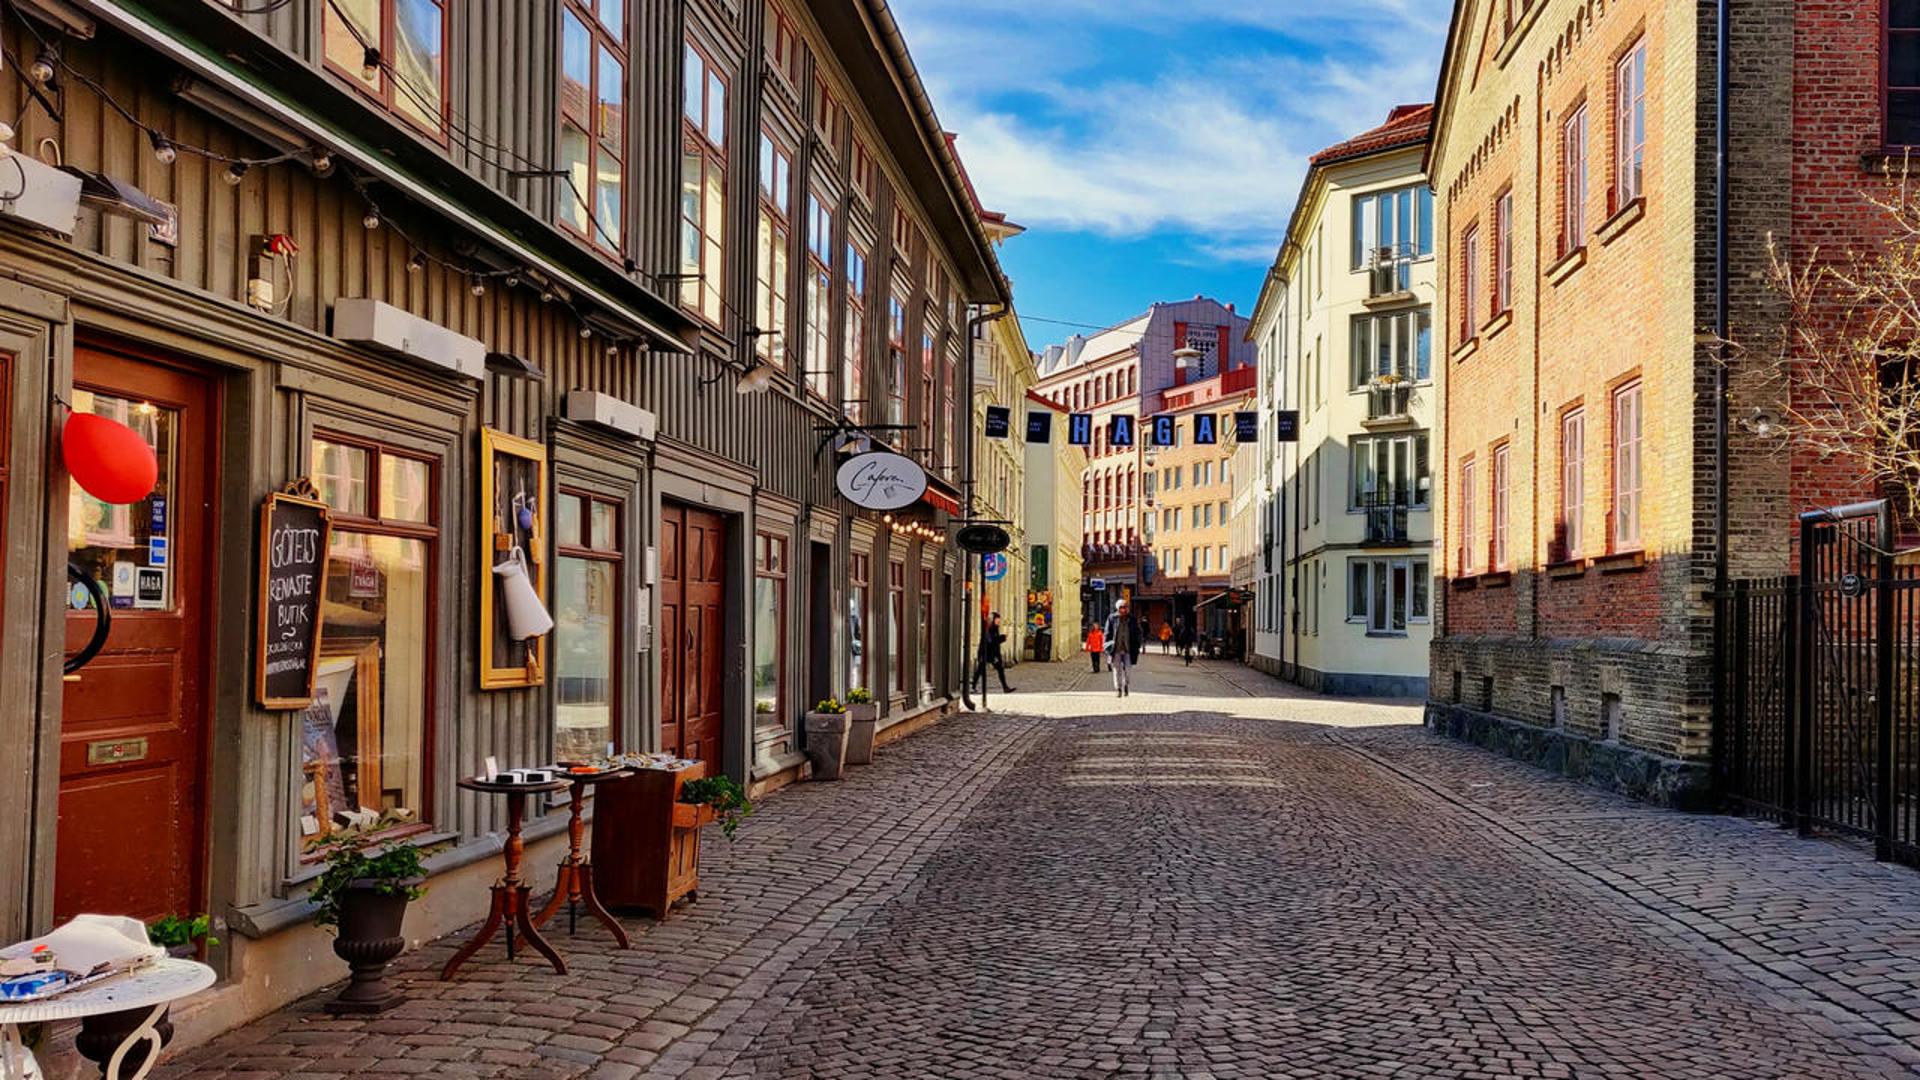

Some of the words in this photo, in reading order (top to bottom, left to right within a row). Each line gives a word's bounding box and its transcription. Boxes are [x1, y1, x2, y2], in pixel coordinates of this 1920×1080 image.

[1073, 416, 1213, 444] HAGA
[140, 576, 161, 590] HAGA
[269, 575, 313, 601] RENASTE
[277, 604, 309, 627] BUTIK
